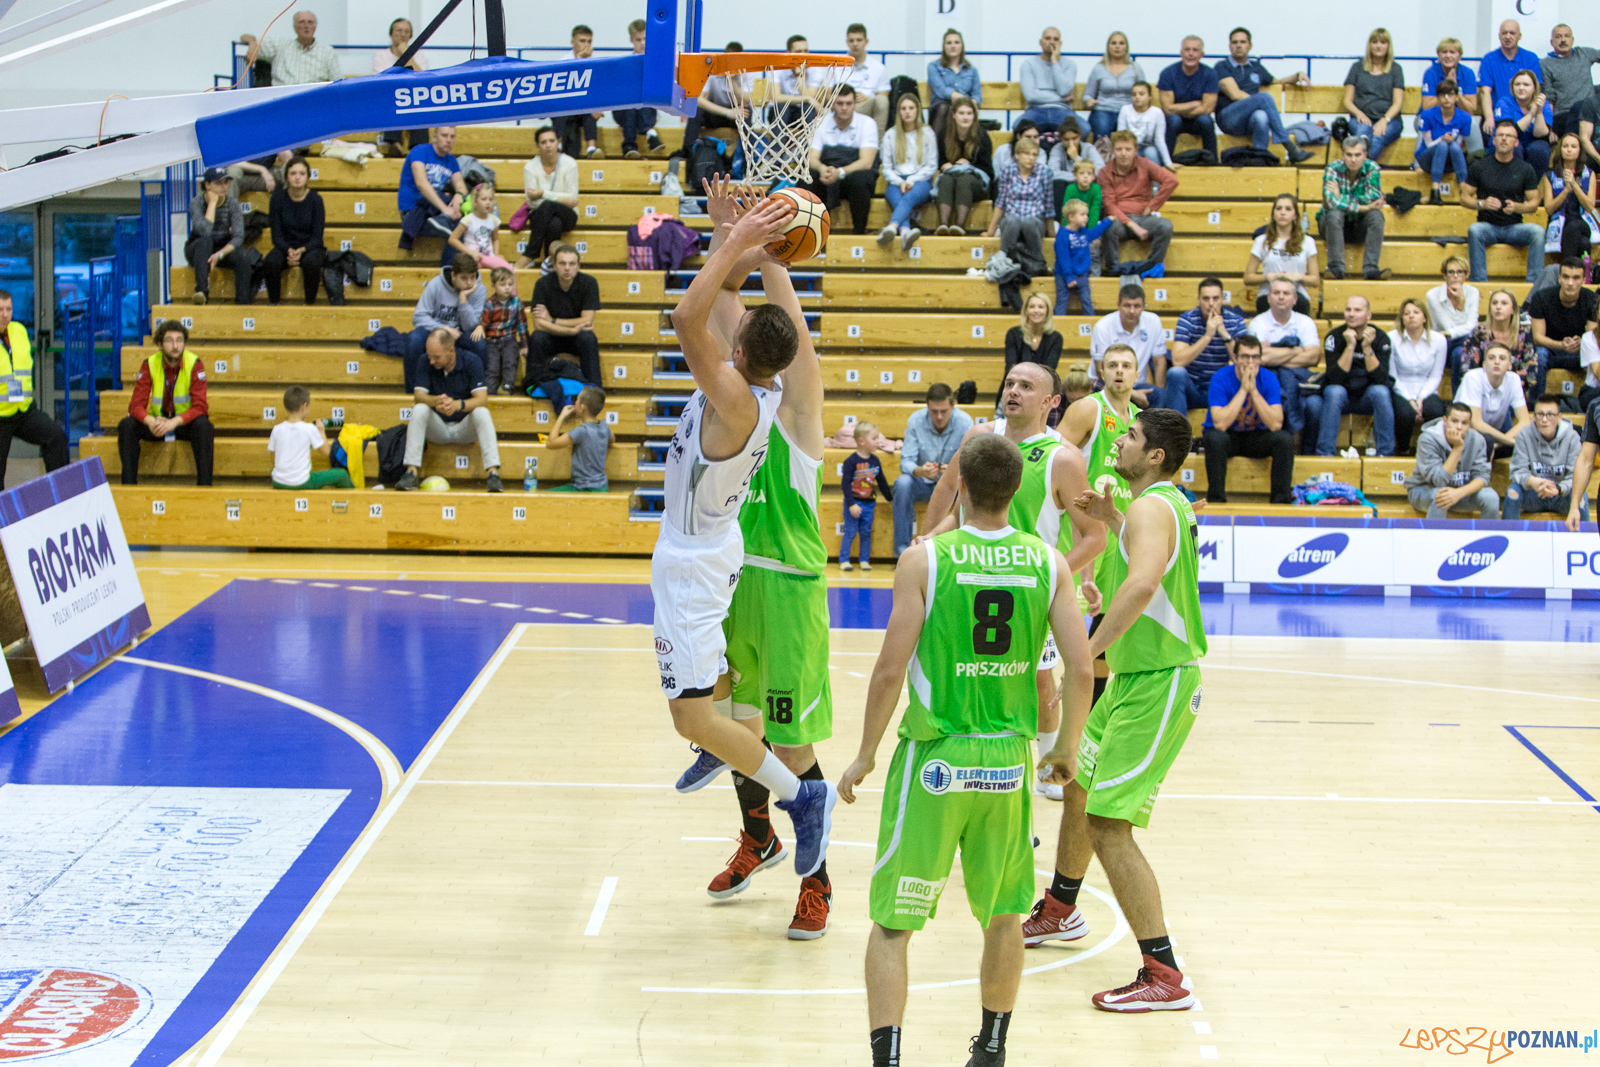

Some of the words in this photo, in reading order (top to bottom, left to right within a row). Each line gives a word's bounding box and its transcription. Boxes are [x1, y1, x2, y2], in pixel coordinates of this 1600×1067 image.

[394, 82, 483, 107] SPORT
[485, 69, 593, 104] SYSTEM
[653, 173, 659, 181] 9
[1211, 214, 1217, 222] 2
[855, 248, 860, 256] 8
[974, 249, 980, 257] 6
[382, 282, 391, 290] 13
[631, 283, 637, 292] 9
[1158, 290, 1164, 299] 3
[245, 319, 255, 328] 15
[370, 321, 380, 330] 13
[625, 324, 631, 333] 9
[851, 327, 857, 335] 8
[975, 327, 981, 336] 6
[1081, 325, 1091, 334] 15
[1165, 330, 1171, 339] 3
[217, 362, 227, 371] 15
[348, 363, 358, 372] 13
[617, 368, 623, 376] 9
[850, 371, 856, 380] 8
[912, 371, 918, 380] 7
[884, 373, 890, 381] 5
[265, 409, 275, 418] 14
[334, 409, 344, 418] 13
[401, 410, 411, 419] 12
[538, 412, 548, 421] 10
[609, 413, 615, 422] 9
[1027, 447, 1044, 463] 9
[458, 458, 467, 466] 11
[1185, 471, 1191, 480] 3
[1393, 473, 1404, 482] 16
[154, 503, 165, 512] 15
[297, 500, 307, 509] 13
[229, 510, 239, 518] 14
[371, 506, 381, 515] 12
[445, 508, 454, 517] 11
[515, 509, 525, 518] 10
[28, 515, 116, 605] BIOFARM
[949, 544, 1043, 567] UNIBEN
[1288, 547, 1337, 564] atrem
[1448, 550, 1497, 567] atrem
[972, 589, 1015, 656] 8
[766, 695, 793, 725] 18
[963, 779, 1019, 790] INVESTMENT
[900, 881, 932, 897] LOGO
[0, 978, 119, 1051] CLASSIC
